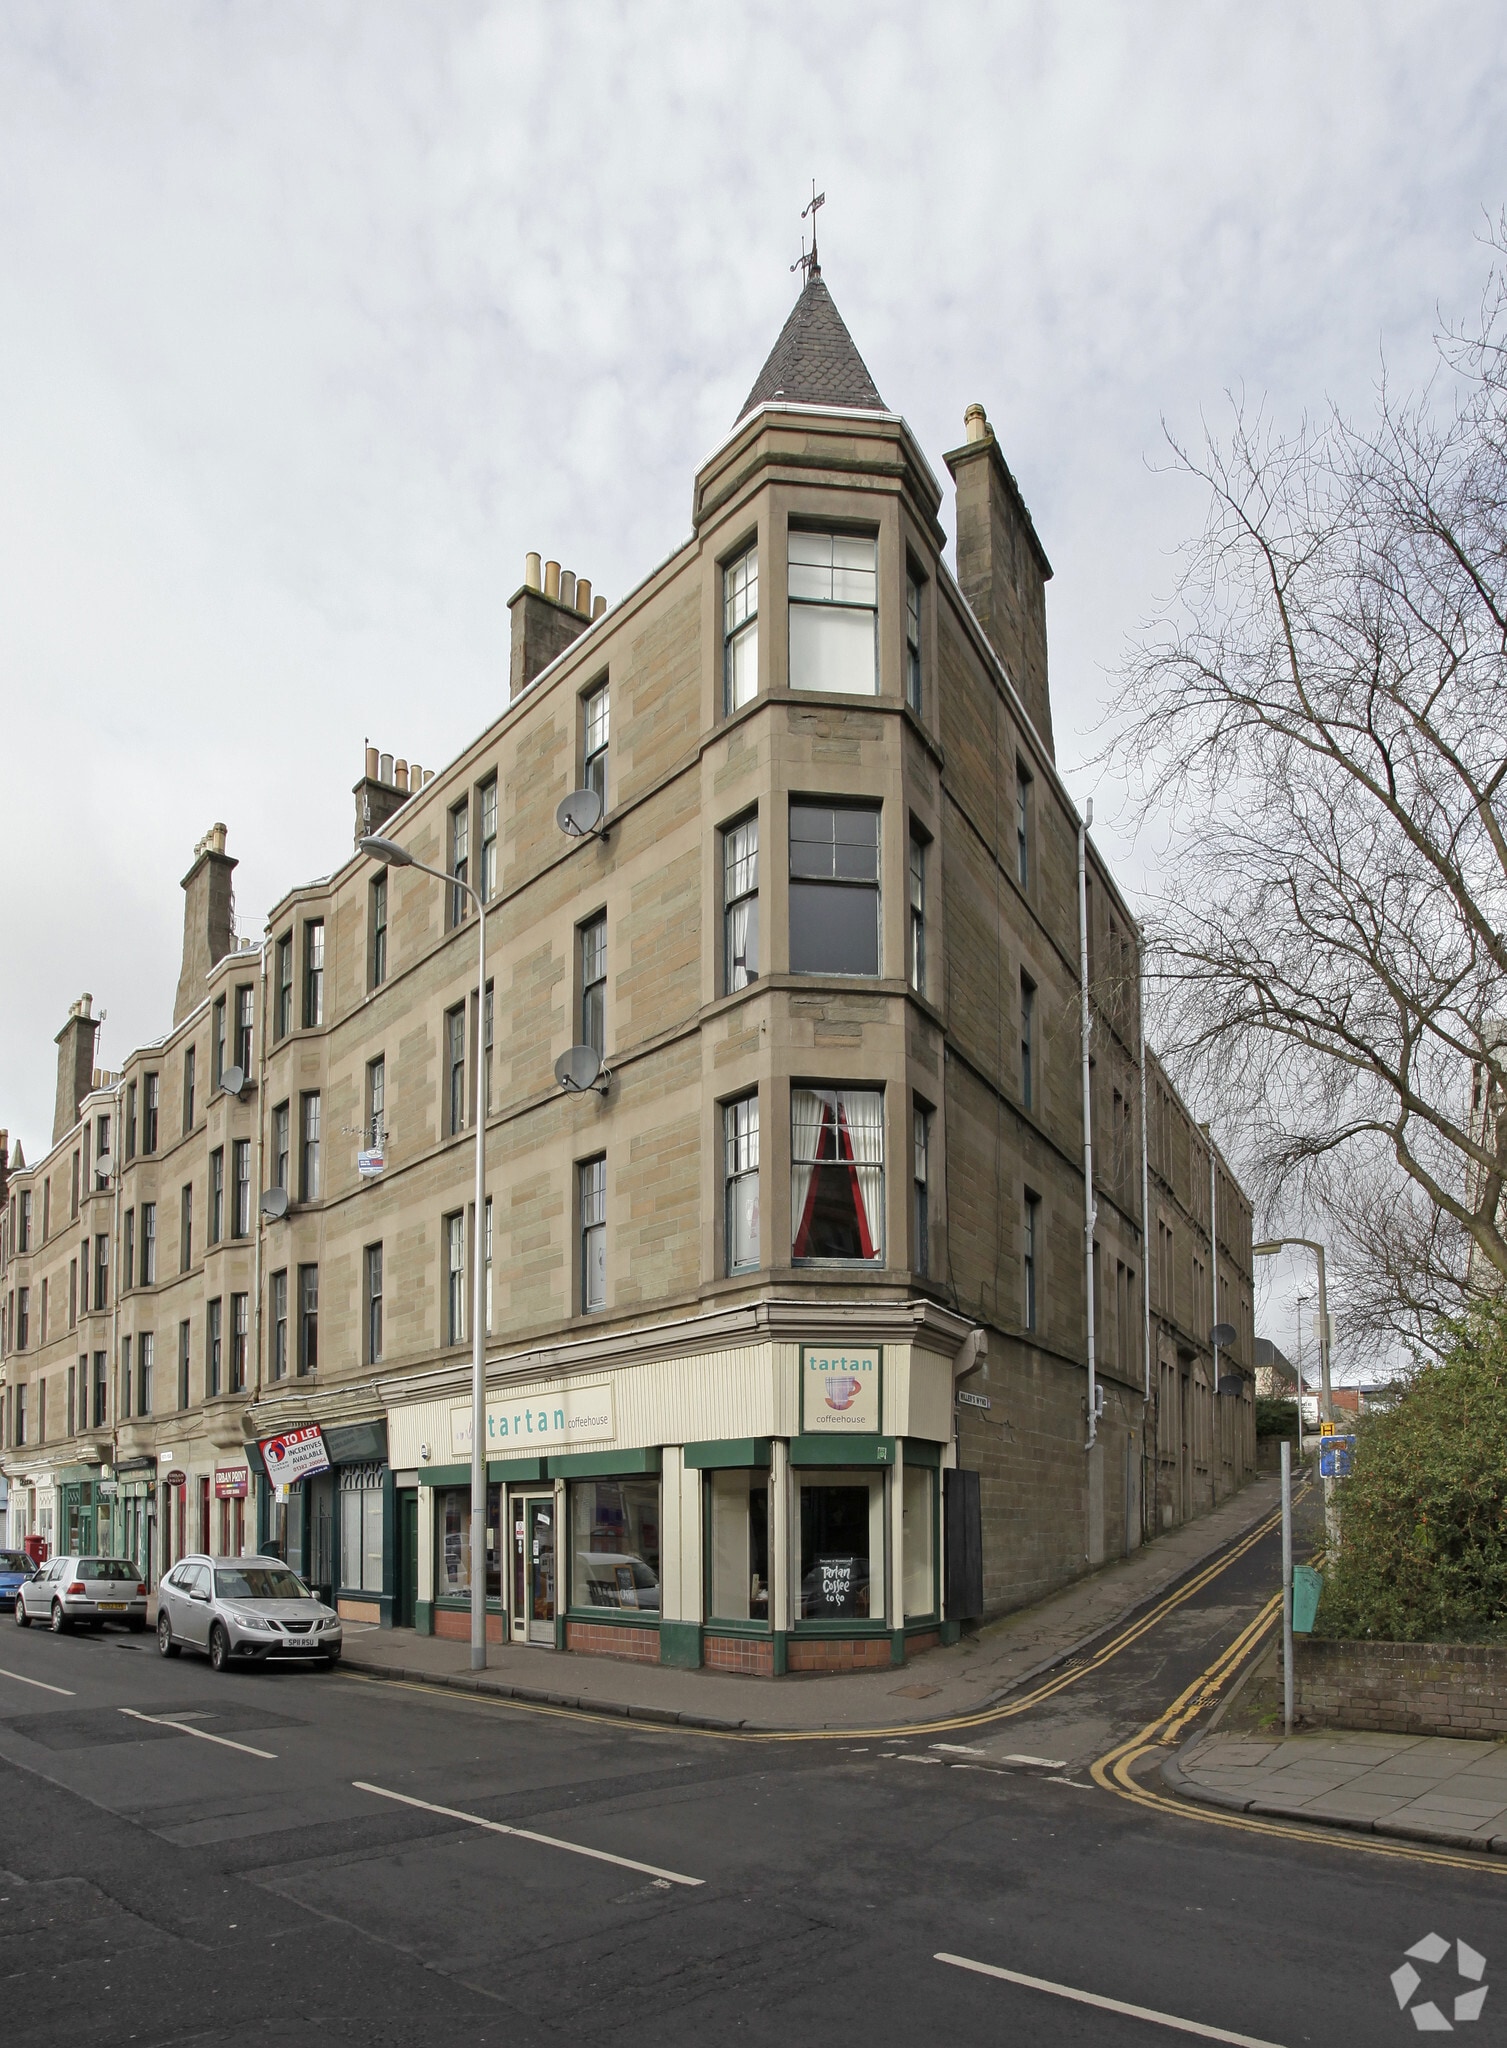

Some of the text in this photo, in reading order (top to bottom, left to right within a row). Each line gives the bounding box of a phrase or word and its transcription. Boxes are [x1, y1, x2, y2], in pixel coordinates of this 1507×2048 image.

[809, 1356, 872, 1371] tartan
[976, 1396, 987, 1407] WYND
[488, 1408, 608, 1438] tartan coffeehouse
[816, 1415, 866, 1424] coffeehouse
[283, 1426, 318, 1446] TO LET
[287, 1440, 322, 1457] INCENTIVES
[292, 1449, 324, 1465] AVAILABLE
[293, 1463, 308, 1473] 01382
[216, 1470, 247, 1484] URBAN PRINT
[821, 1565, 850, 1580] Tartan
[823, 1579, 850, 1594] Coffee
[825, 1593, 845, 1607] to go
[301, 1638, 314, 1646] RSU
